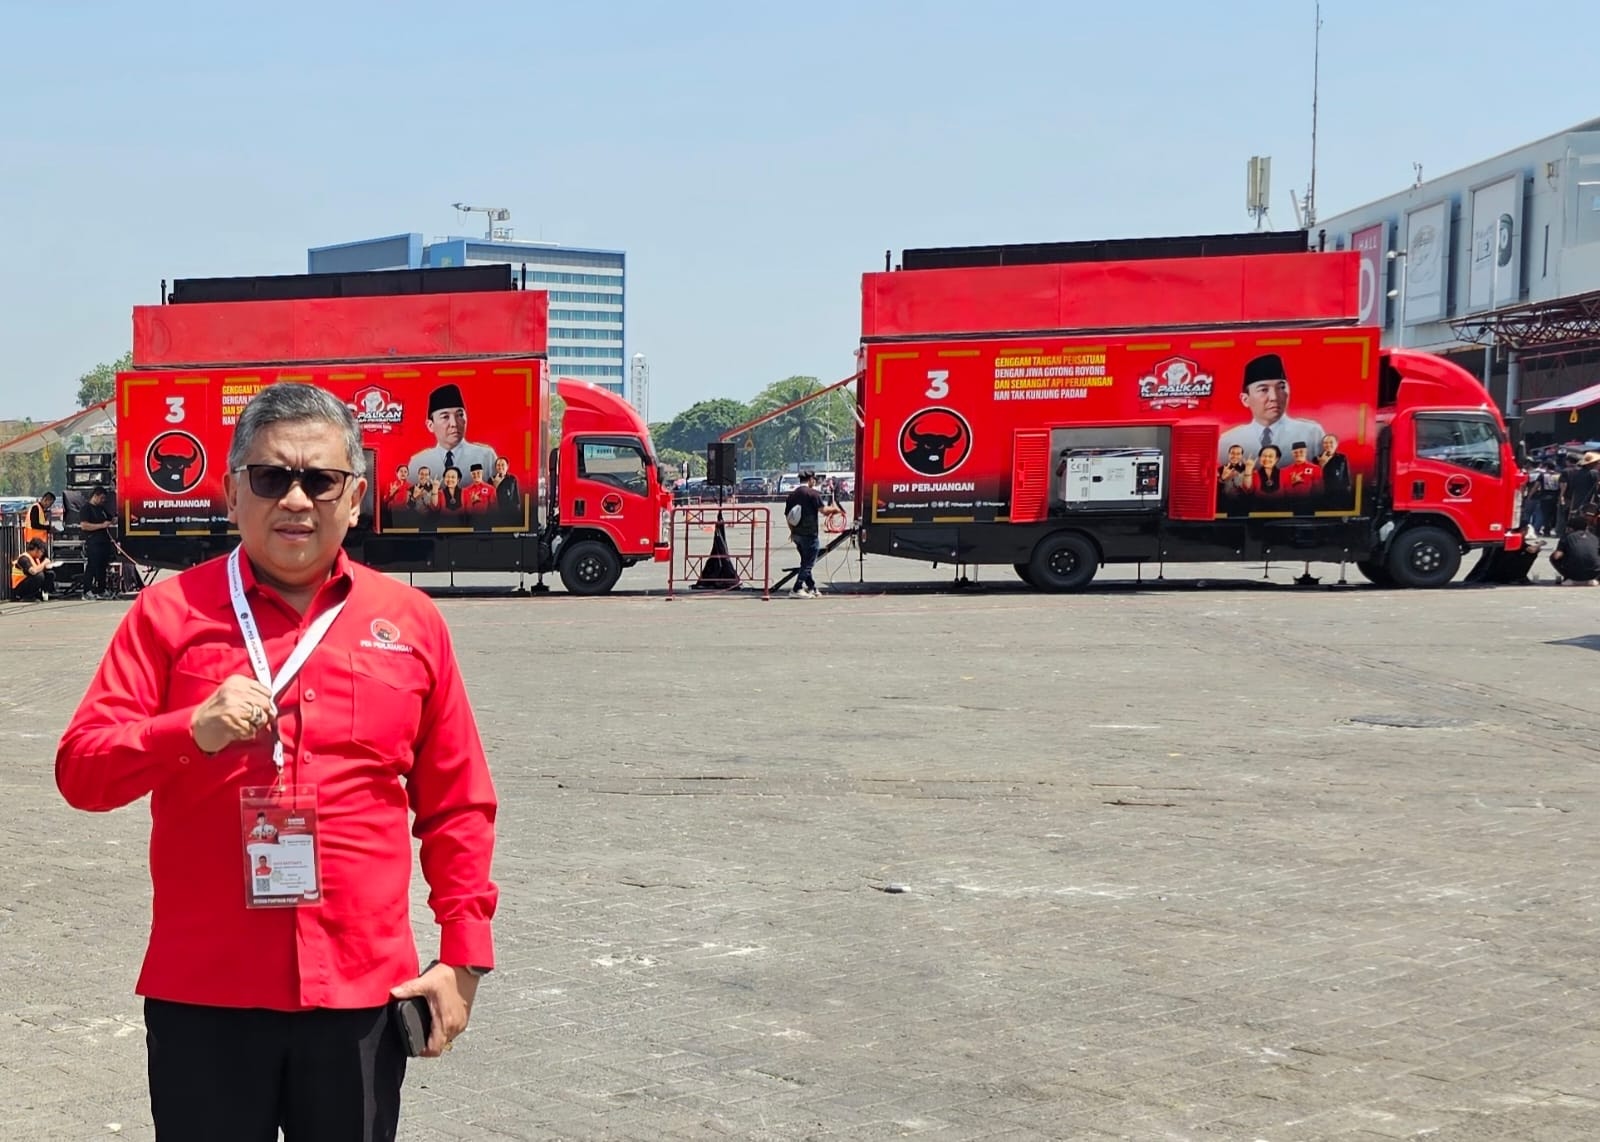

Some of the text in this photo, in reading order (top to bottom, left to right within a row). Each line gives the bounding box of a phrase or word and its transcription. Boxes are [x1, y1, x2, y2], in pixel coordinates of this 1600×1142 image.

[1358, 235, 1377, 249] HALL
[995, 354, 1106, 368] GENGGAM TANGAN PERSATUAN
[994, 365, 1106, 378] DENGAN JIWA GOTONG ROYONG
[925, 370, 949, 399] 3
[994, 376, 1113, 389] DAN SEMANGAT API PERJUANGAN
[993, 388, 1088, 400] NAN TAK KUNJUNG PADAM
[165, 397, 185, 423] 3
[892, 482, 975, 493] PDI PERJUANGAN
[143, 499, 211, 509] PDI PERJUANGAN
